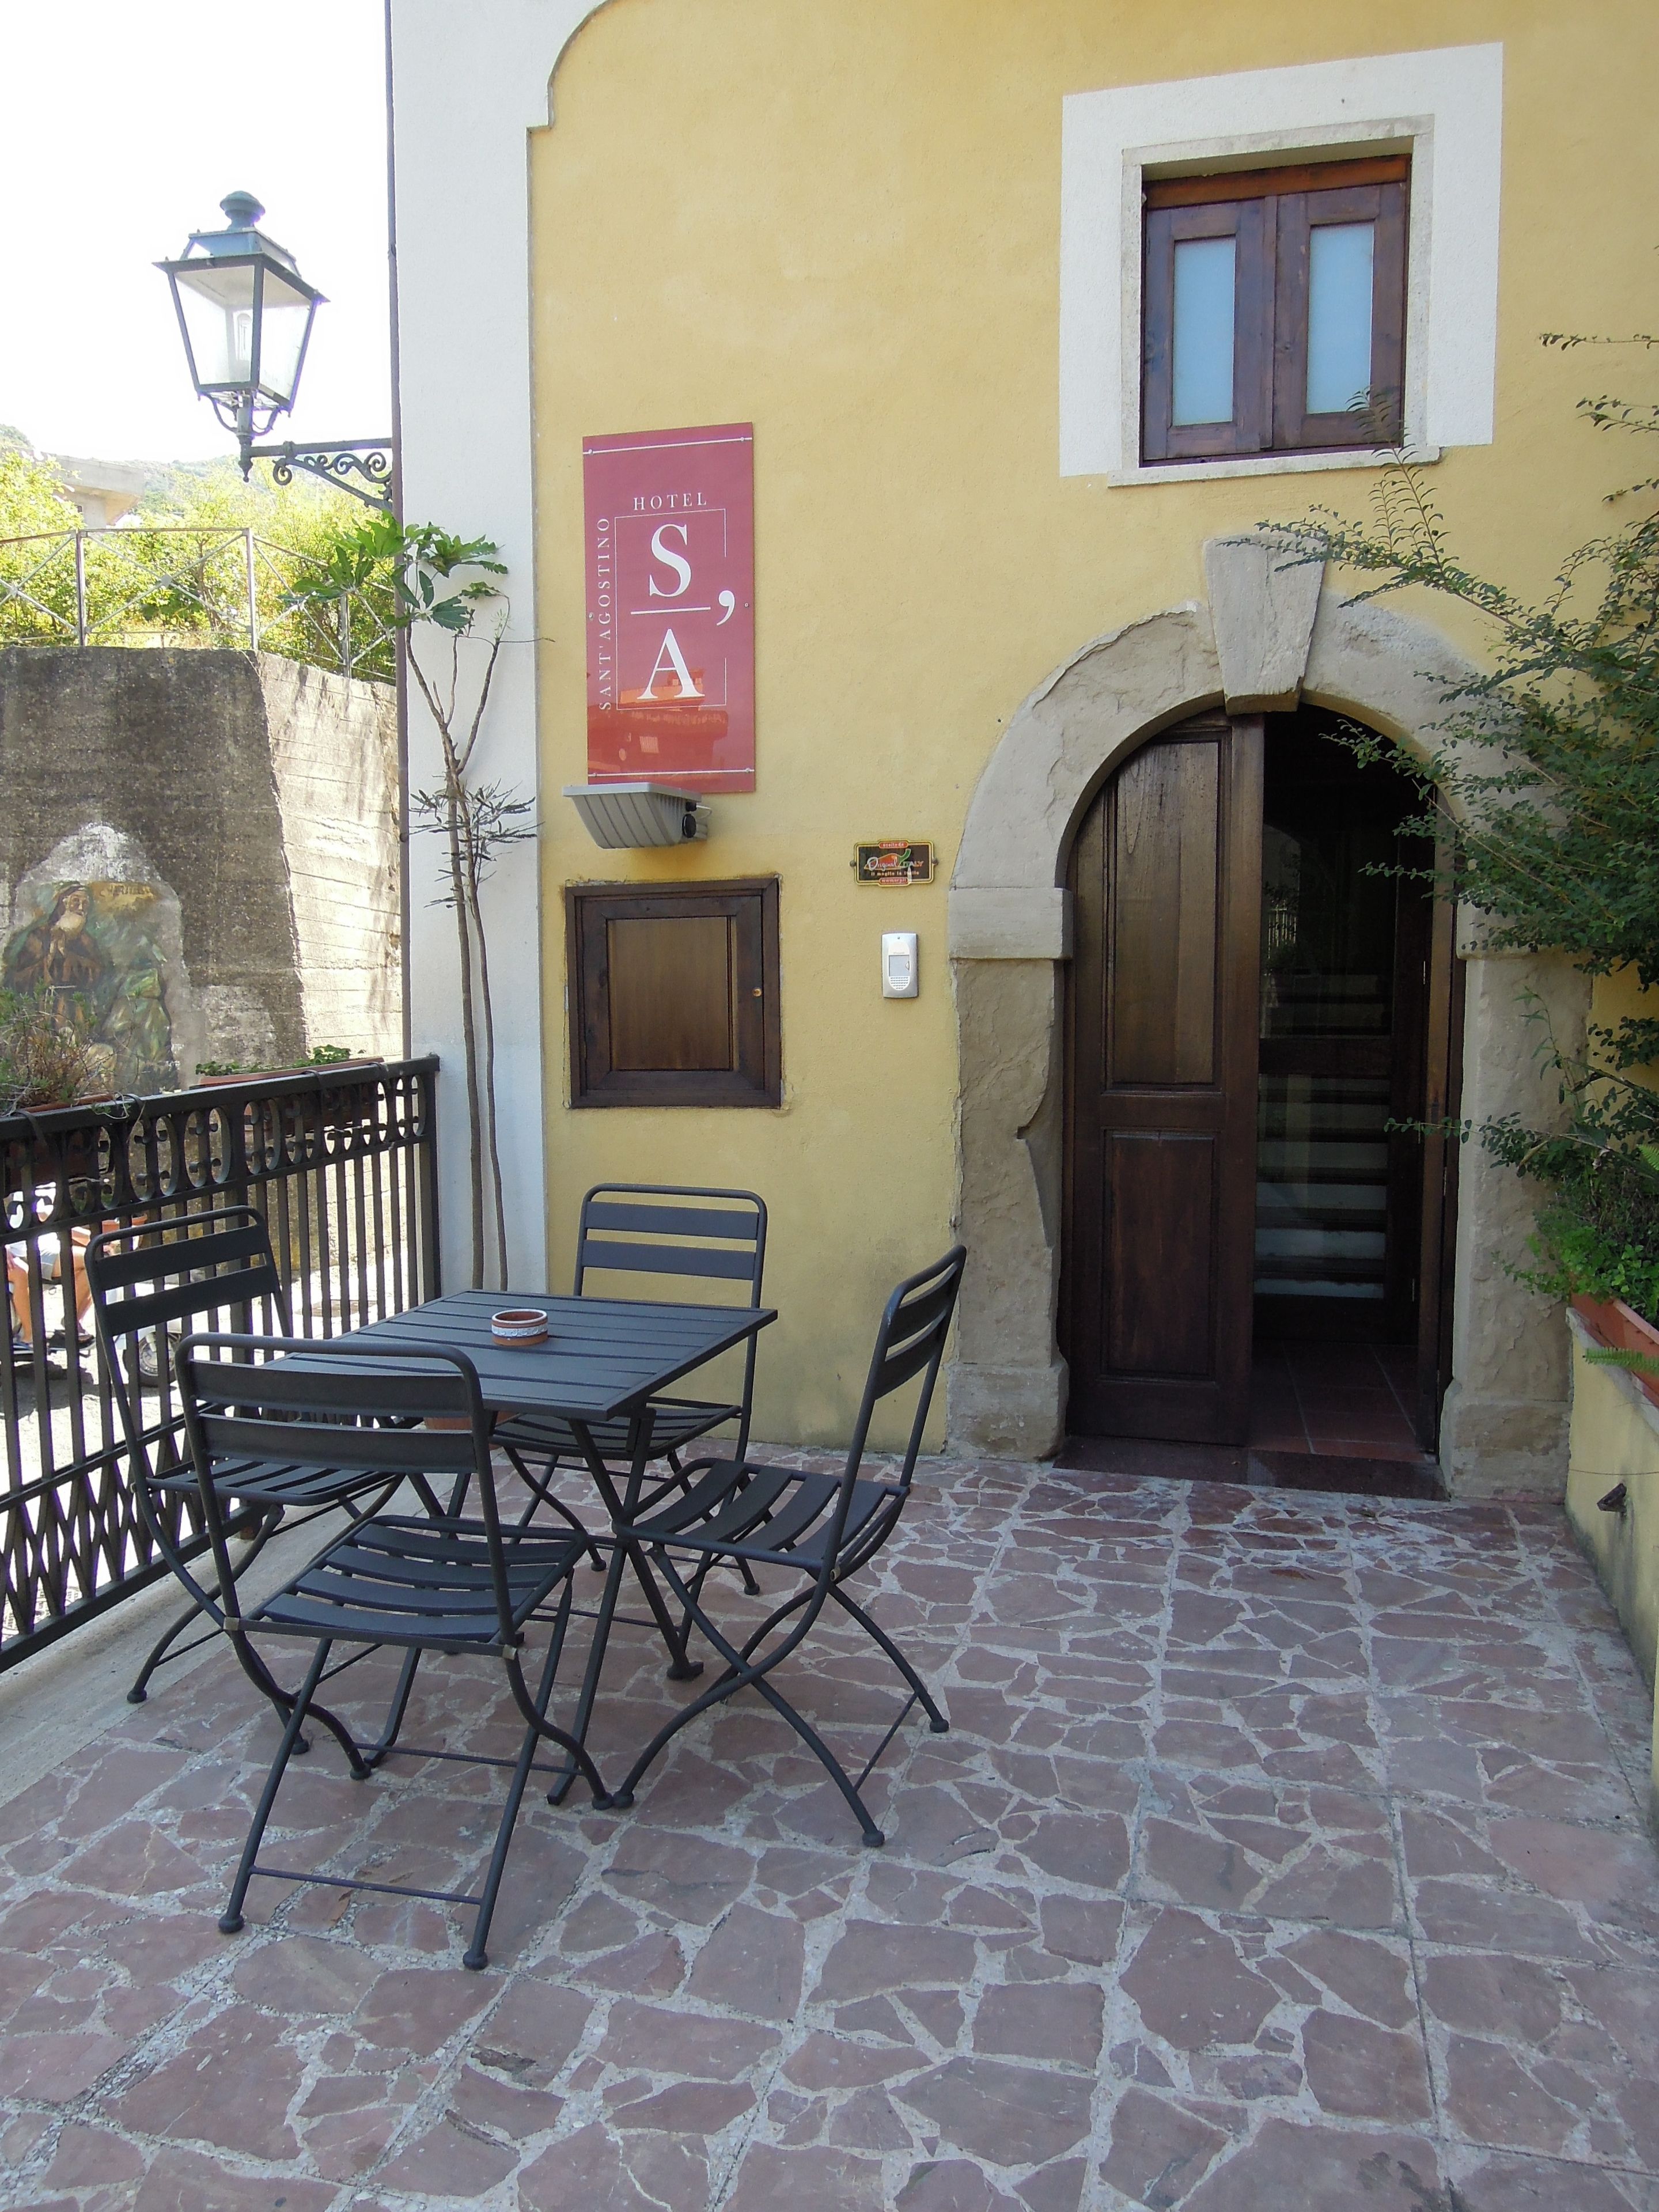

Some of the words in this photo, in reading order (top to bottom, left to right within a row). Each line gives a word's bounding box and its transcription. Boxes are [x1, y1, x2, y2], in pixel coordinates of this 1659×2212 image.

[633, 491, 708, 512] HOTEL
[597, 517, 612, 711] SANT'AGOSTINO
[636, 628, 706, 700] A
